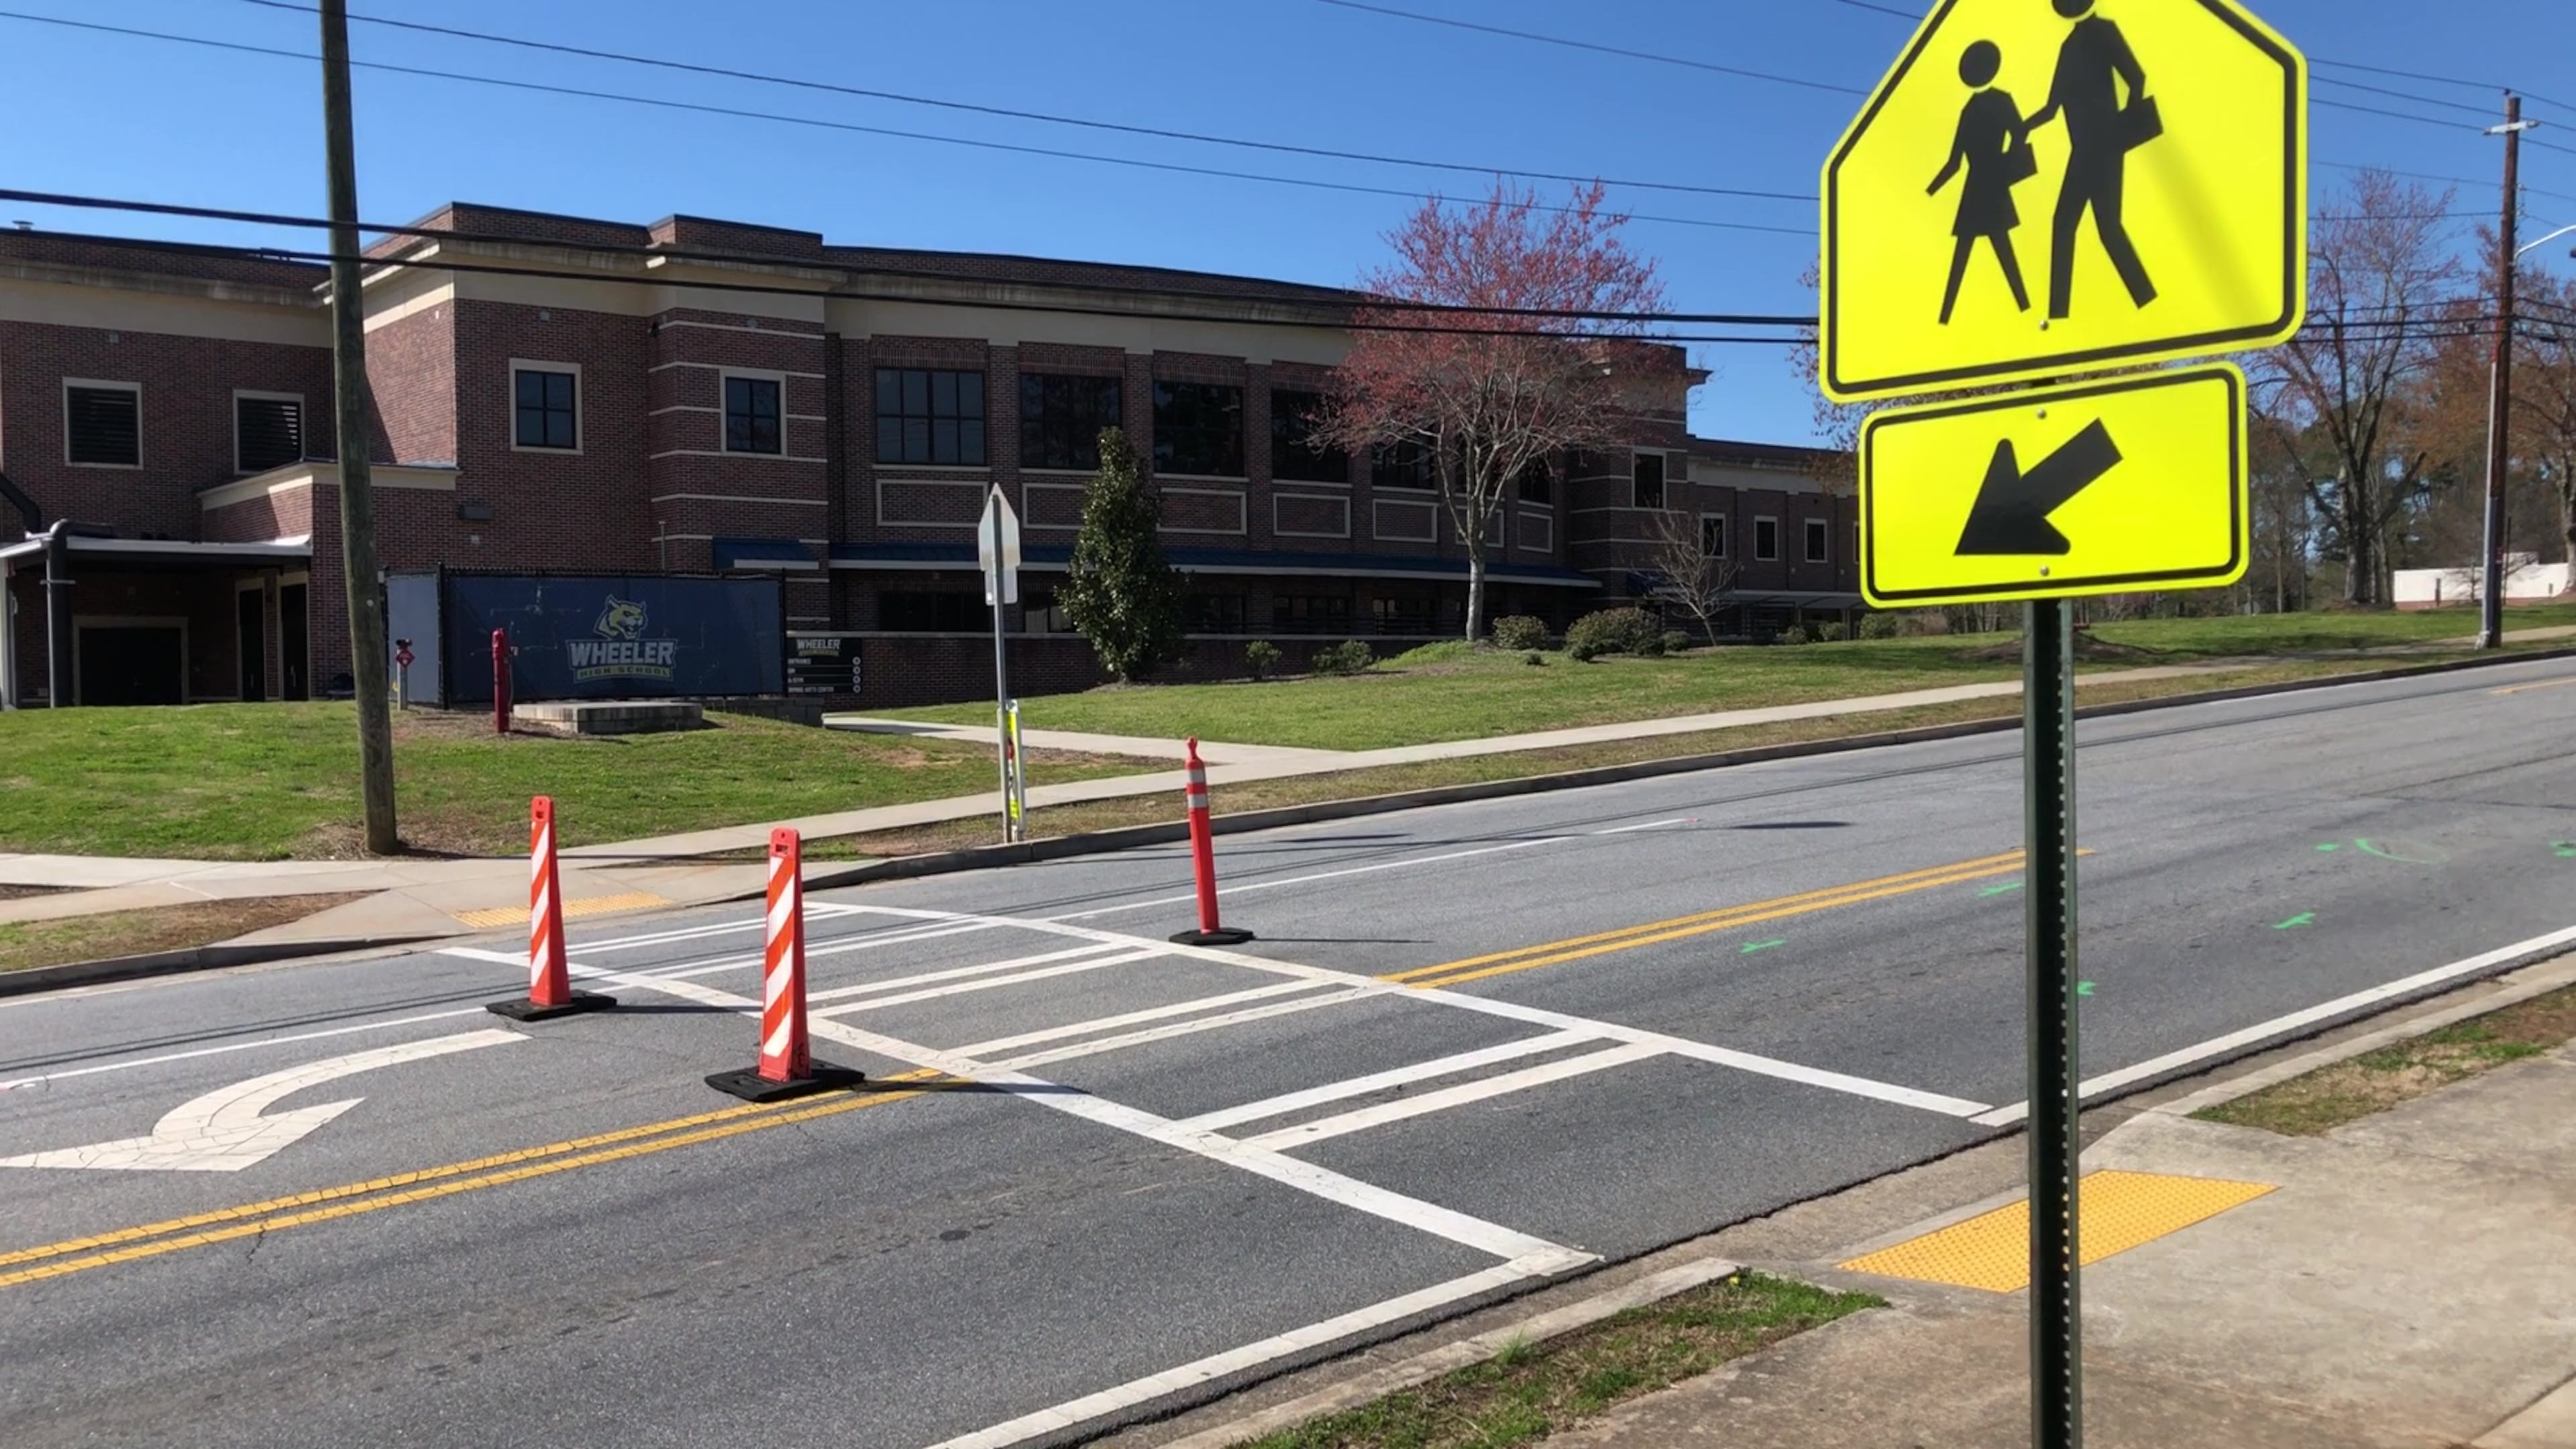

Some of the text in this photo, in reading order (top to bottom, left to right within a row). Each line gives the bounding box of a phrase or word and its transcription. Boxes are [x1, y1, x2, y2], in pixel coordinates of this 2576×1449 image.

[796, 639, 840, 649] WHEELER
[570, 642, 674, 666] WHEELER
[580, 666, 669, 677] HIGH SCHOOL
